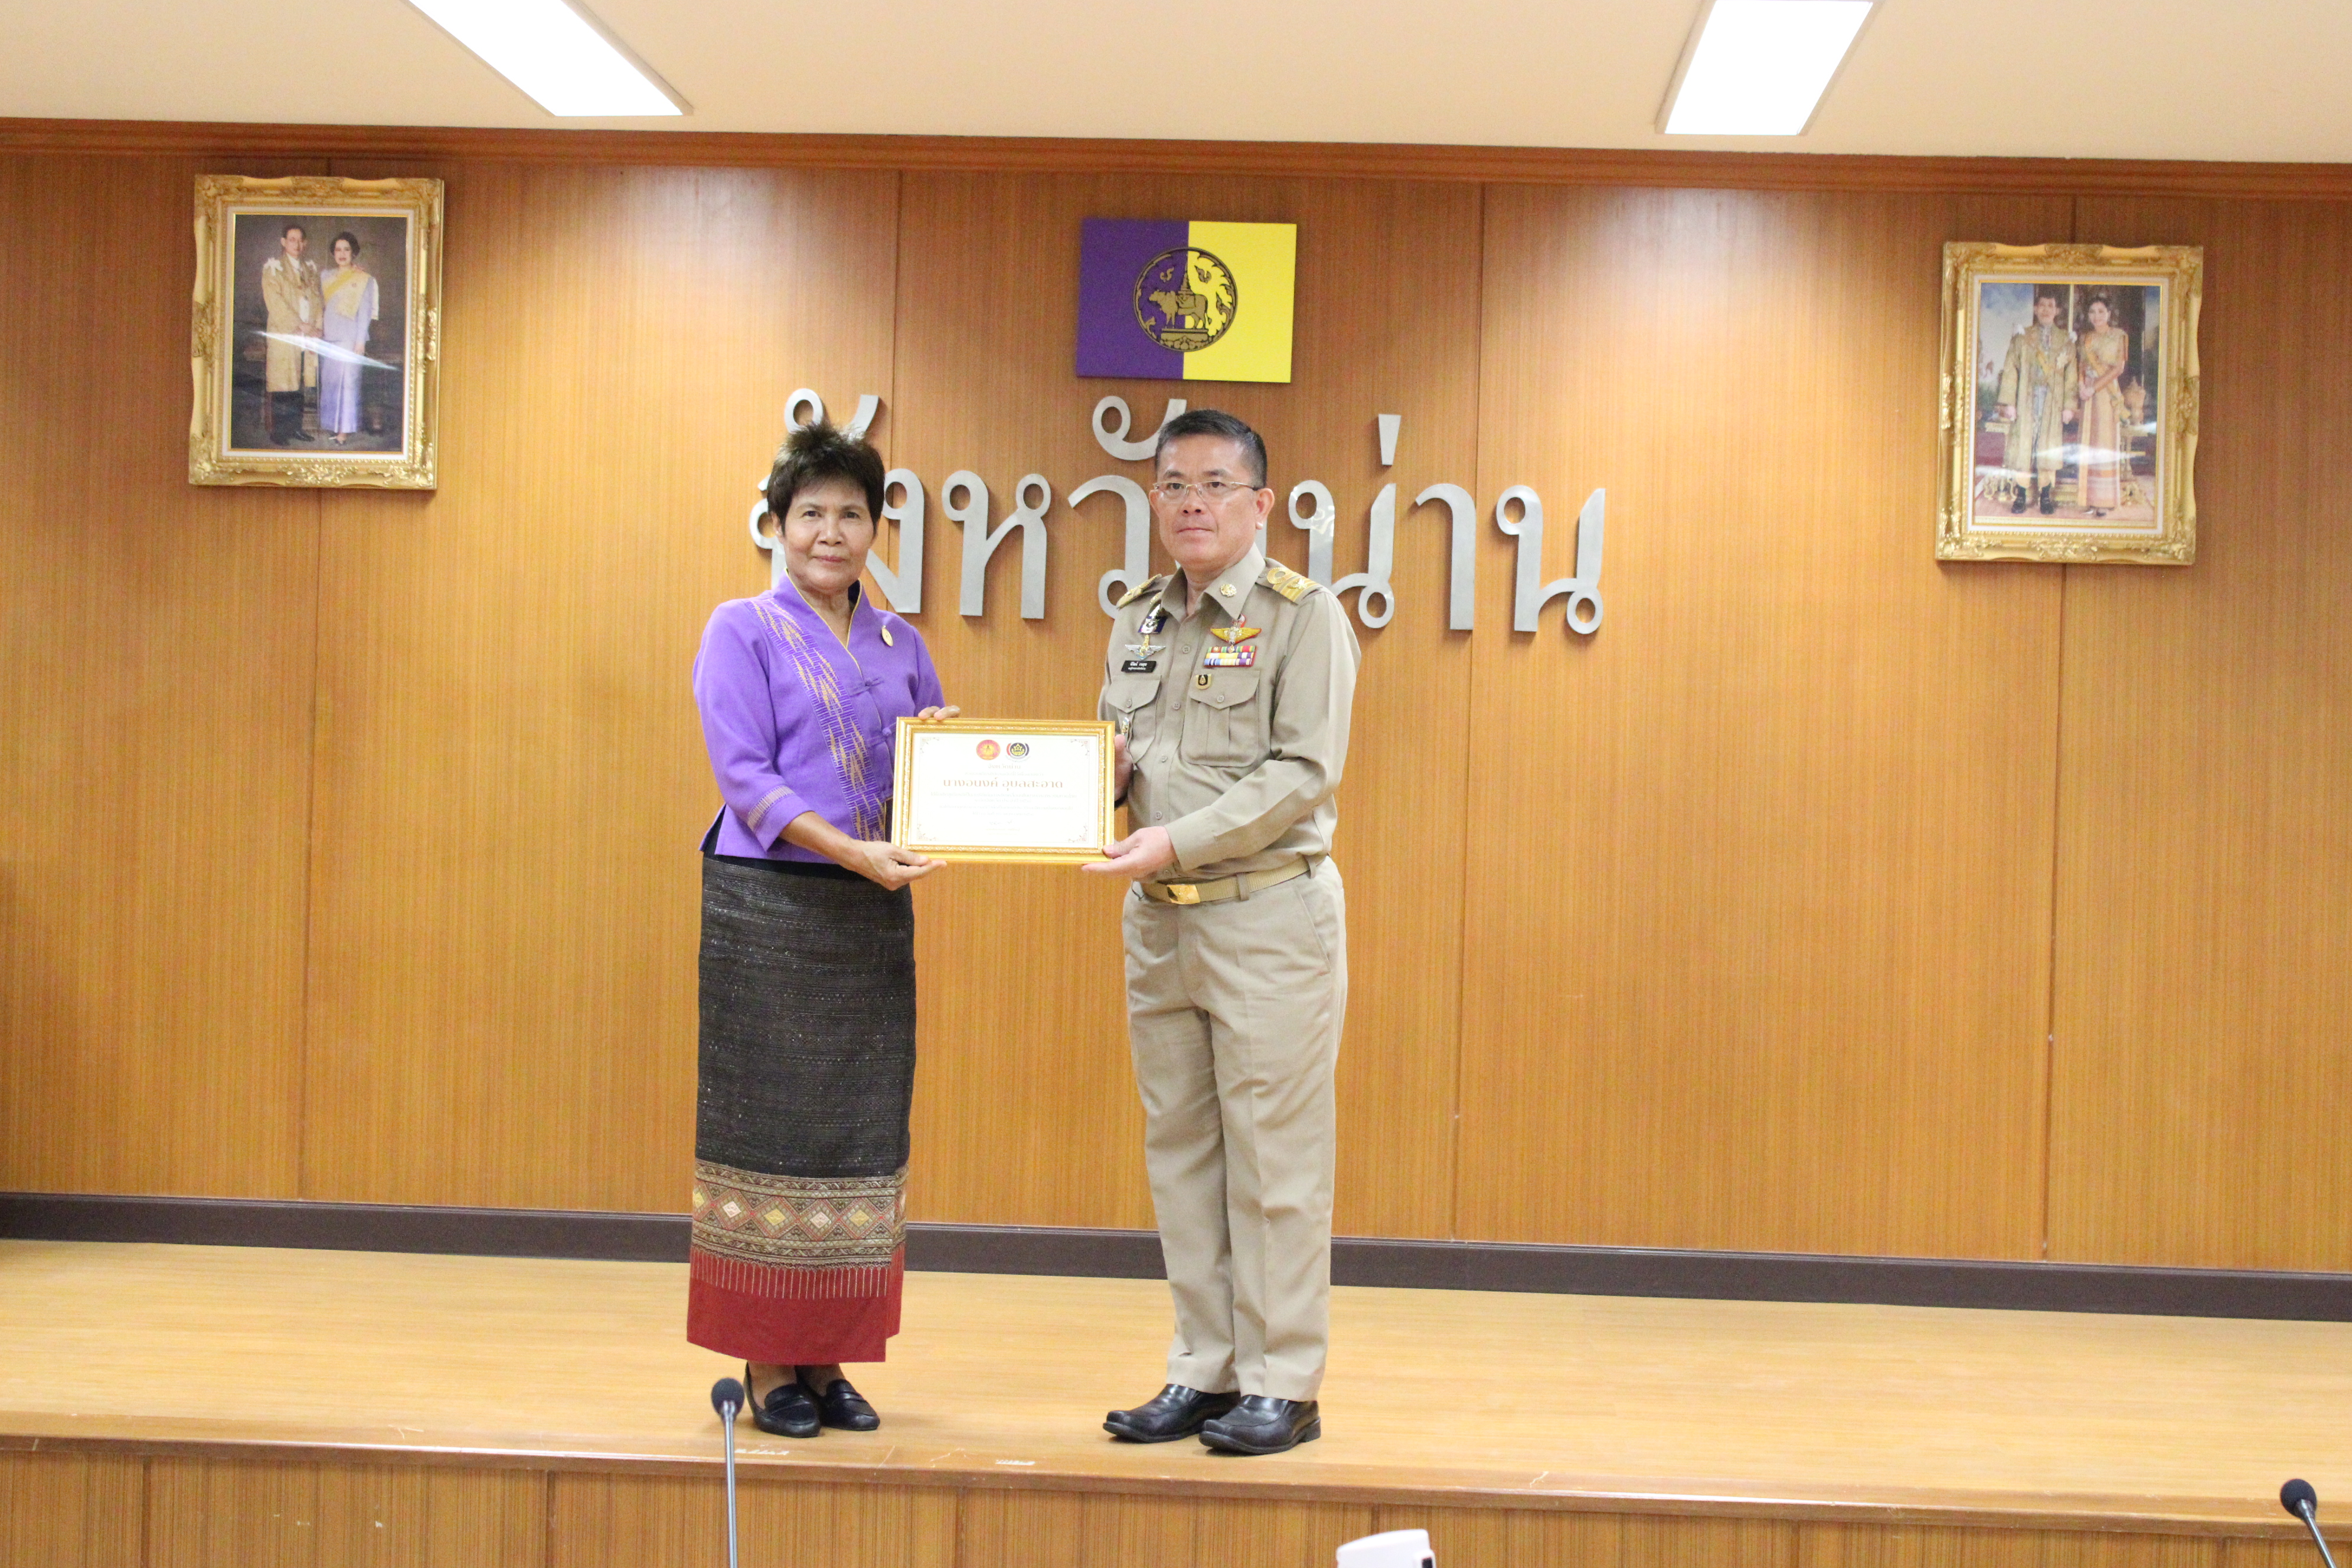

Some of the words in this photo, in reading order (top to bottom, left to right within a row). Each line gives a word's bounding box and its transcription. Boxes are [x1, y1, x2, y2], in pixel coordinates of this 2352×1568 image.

[749, 387, 1606, 635] ังหวัน่าน
[943, 776, 998, 788] นางอนงค์
[1002, 779, 1063, 792] อุบลสะอาด
